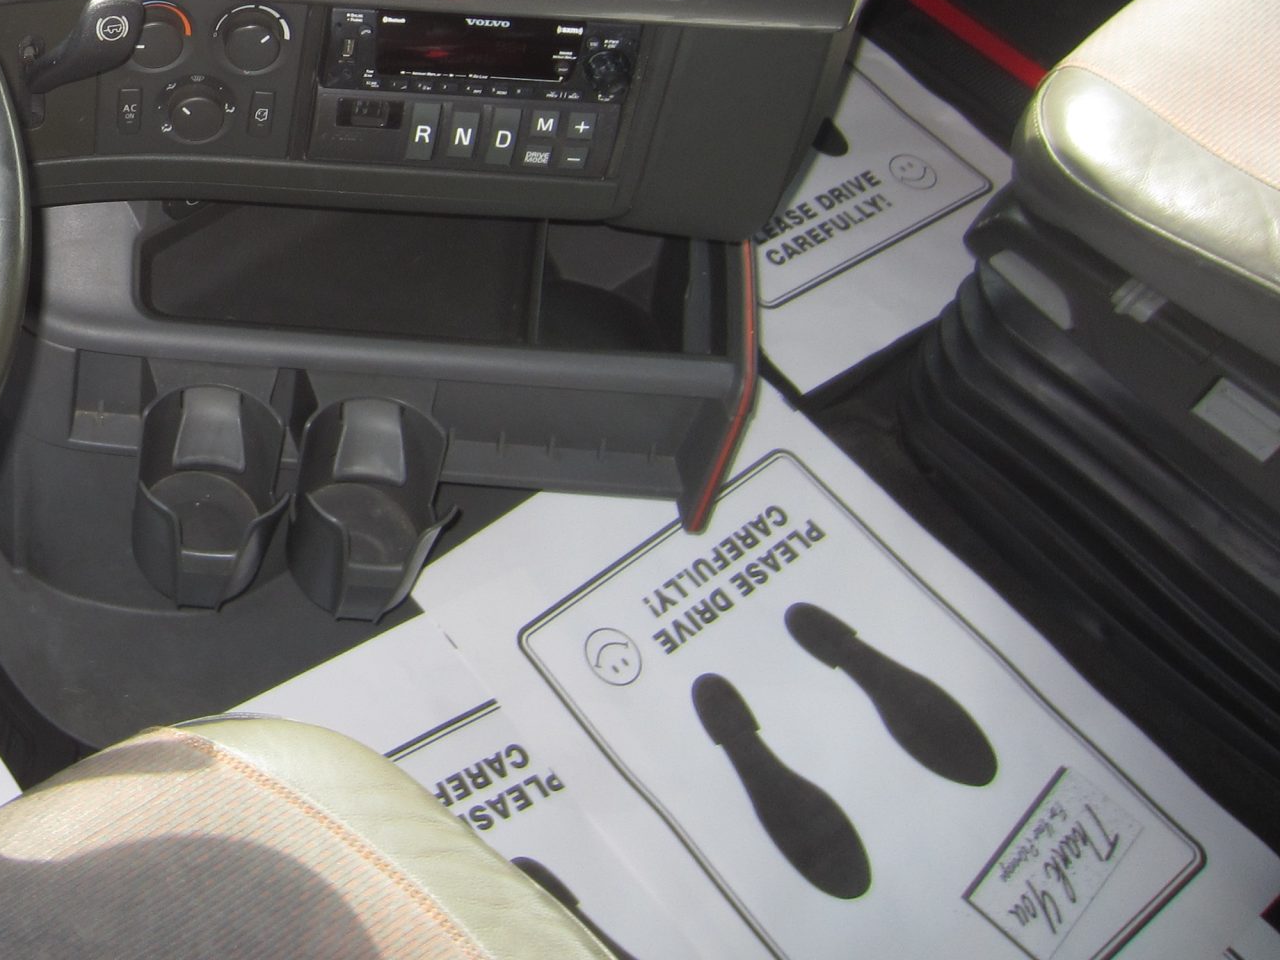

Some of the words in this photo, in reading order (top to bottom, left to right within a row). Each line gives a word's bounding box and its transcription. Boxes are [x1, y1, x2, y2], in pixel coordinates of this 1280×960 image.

[465, 18, 511, 28] VOLVO
[415, 125, 431, 143] R
[454, 127, 472, 146] N
[495, 130, 512, 148] D
[536, 118, 554, 132] M
[524, 156, 549, 165] MODE
[525, 150, 550, 159] DRIVE
[815, 170, 883, 211] DRIVE
[765, 193, 893, 267] CAREFULLY!
[642, 505, 788, 618] CAREFULLY!
[729, 519, 827, 597] PLEASE
[652, 587, 735, 655] DRIVE
[1043, 803, 1120, 904] Thank
[1008, 879, 1063, 935] You
